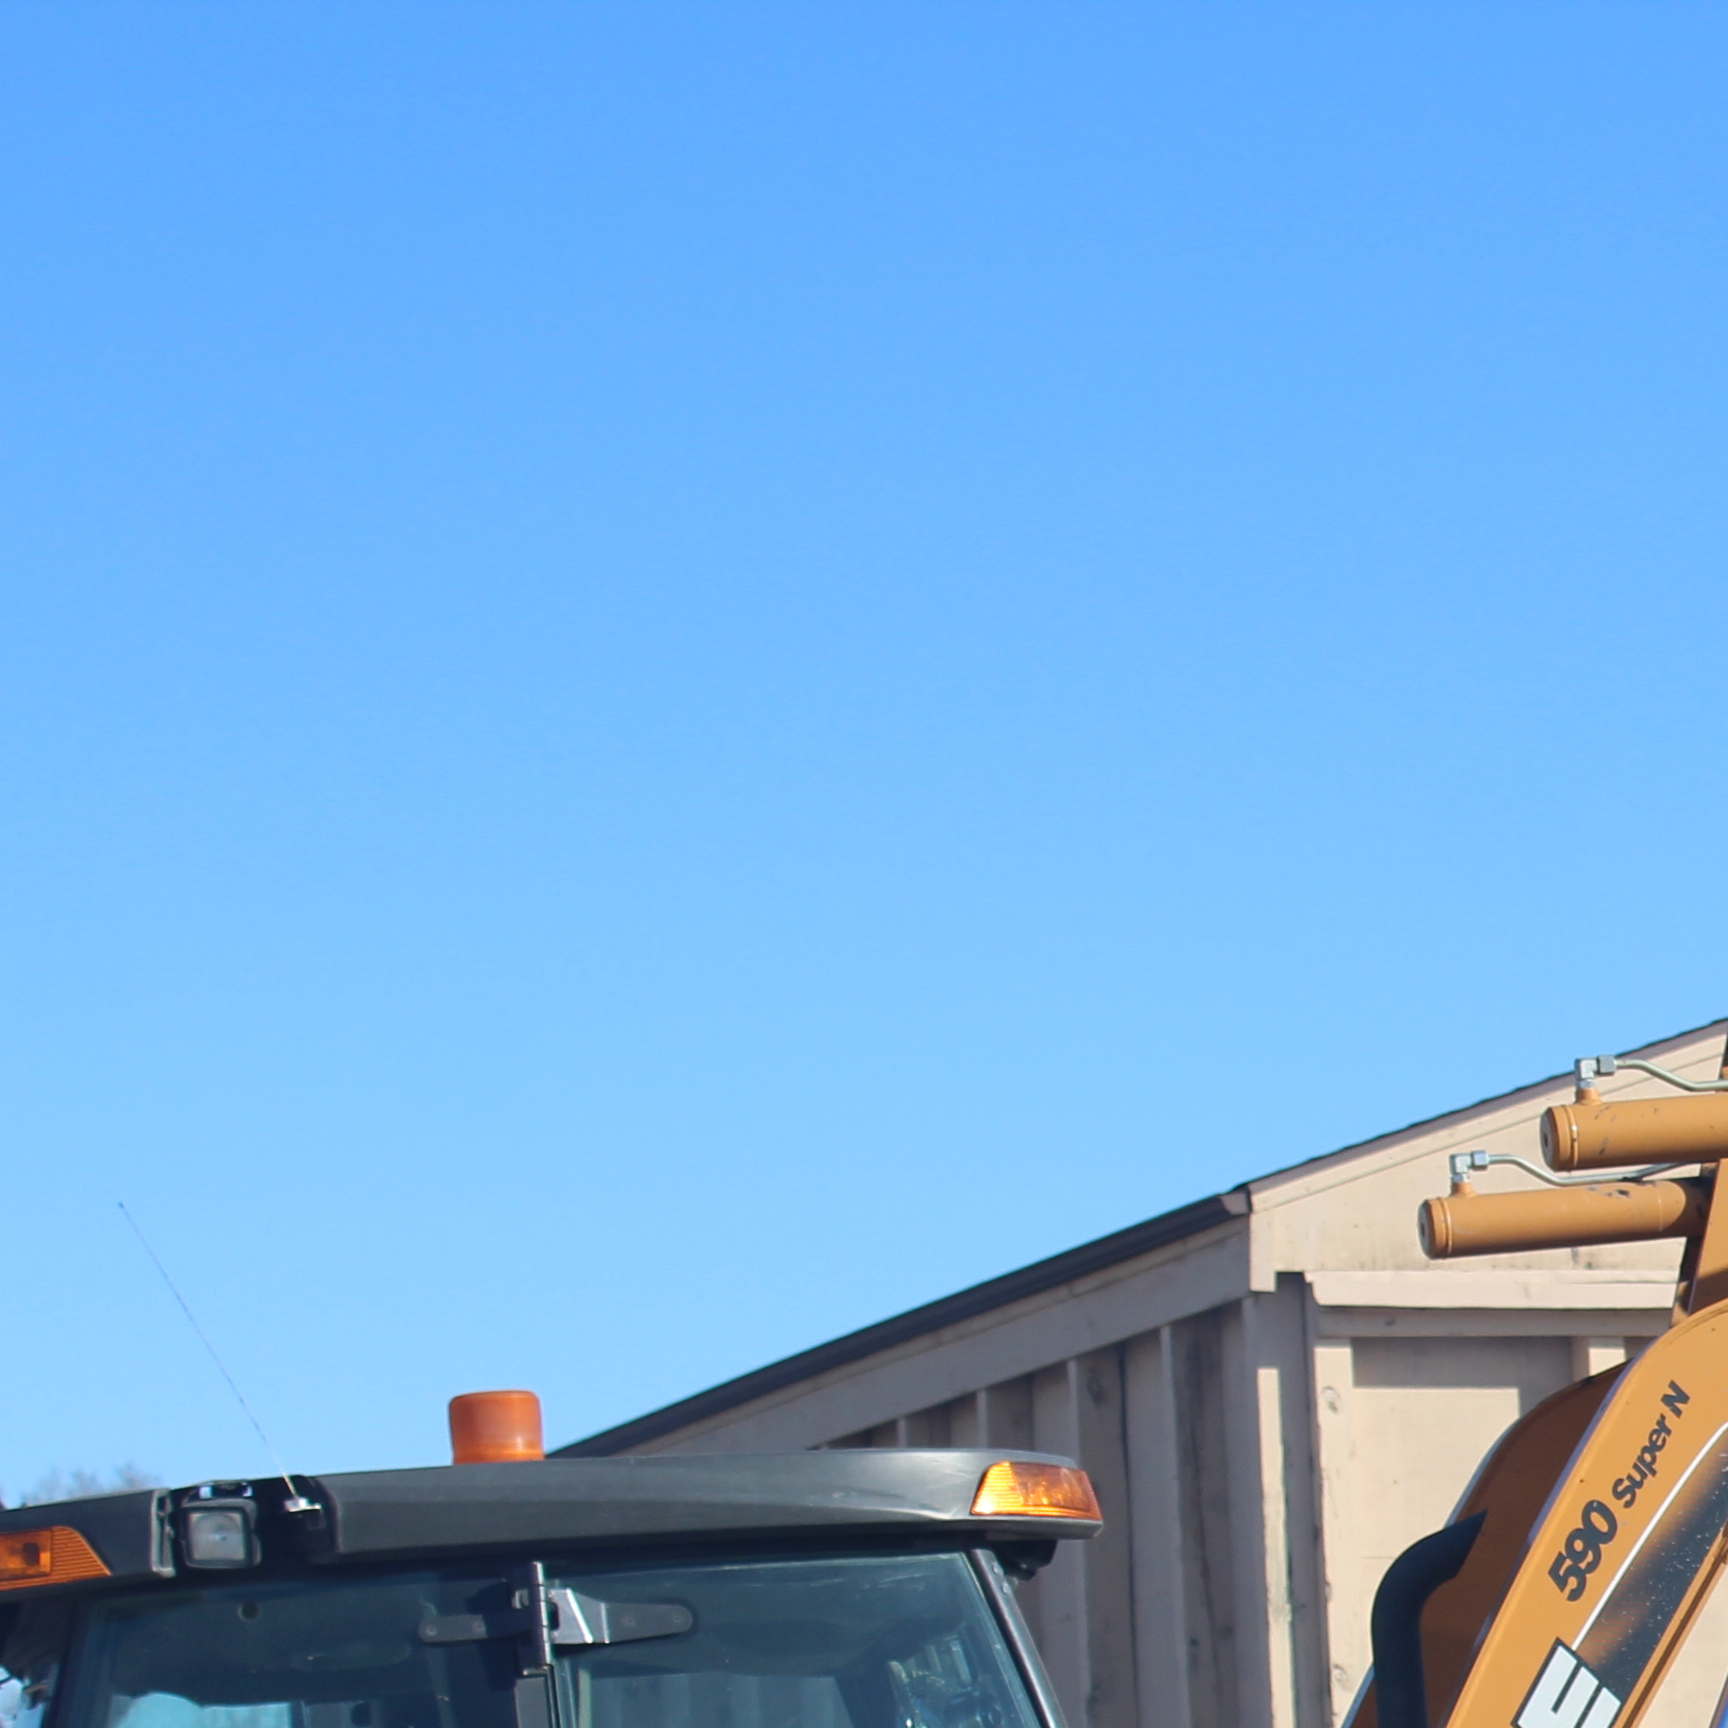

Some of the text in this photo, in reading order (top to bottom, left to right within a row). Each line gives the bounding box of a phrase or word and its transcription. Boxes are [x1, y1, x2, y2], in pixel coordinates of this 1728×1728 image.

[1547, 1380, 1691, 1602] 590 Super N
